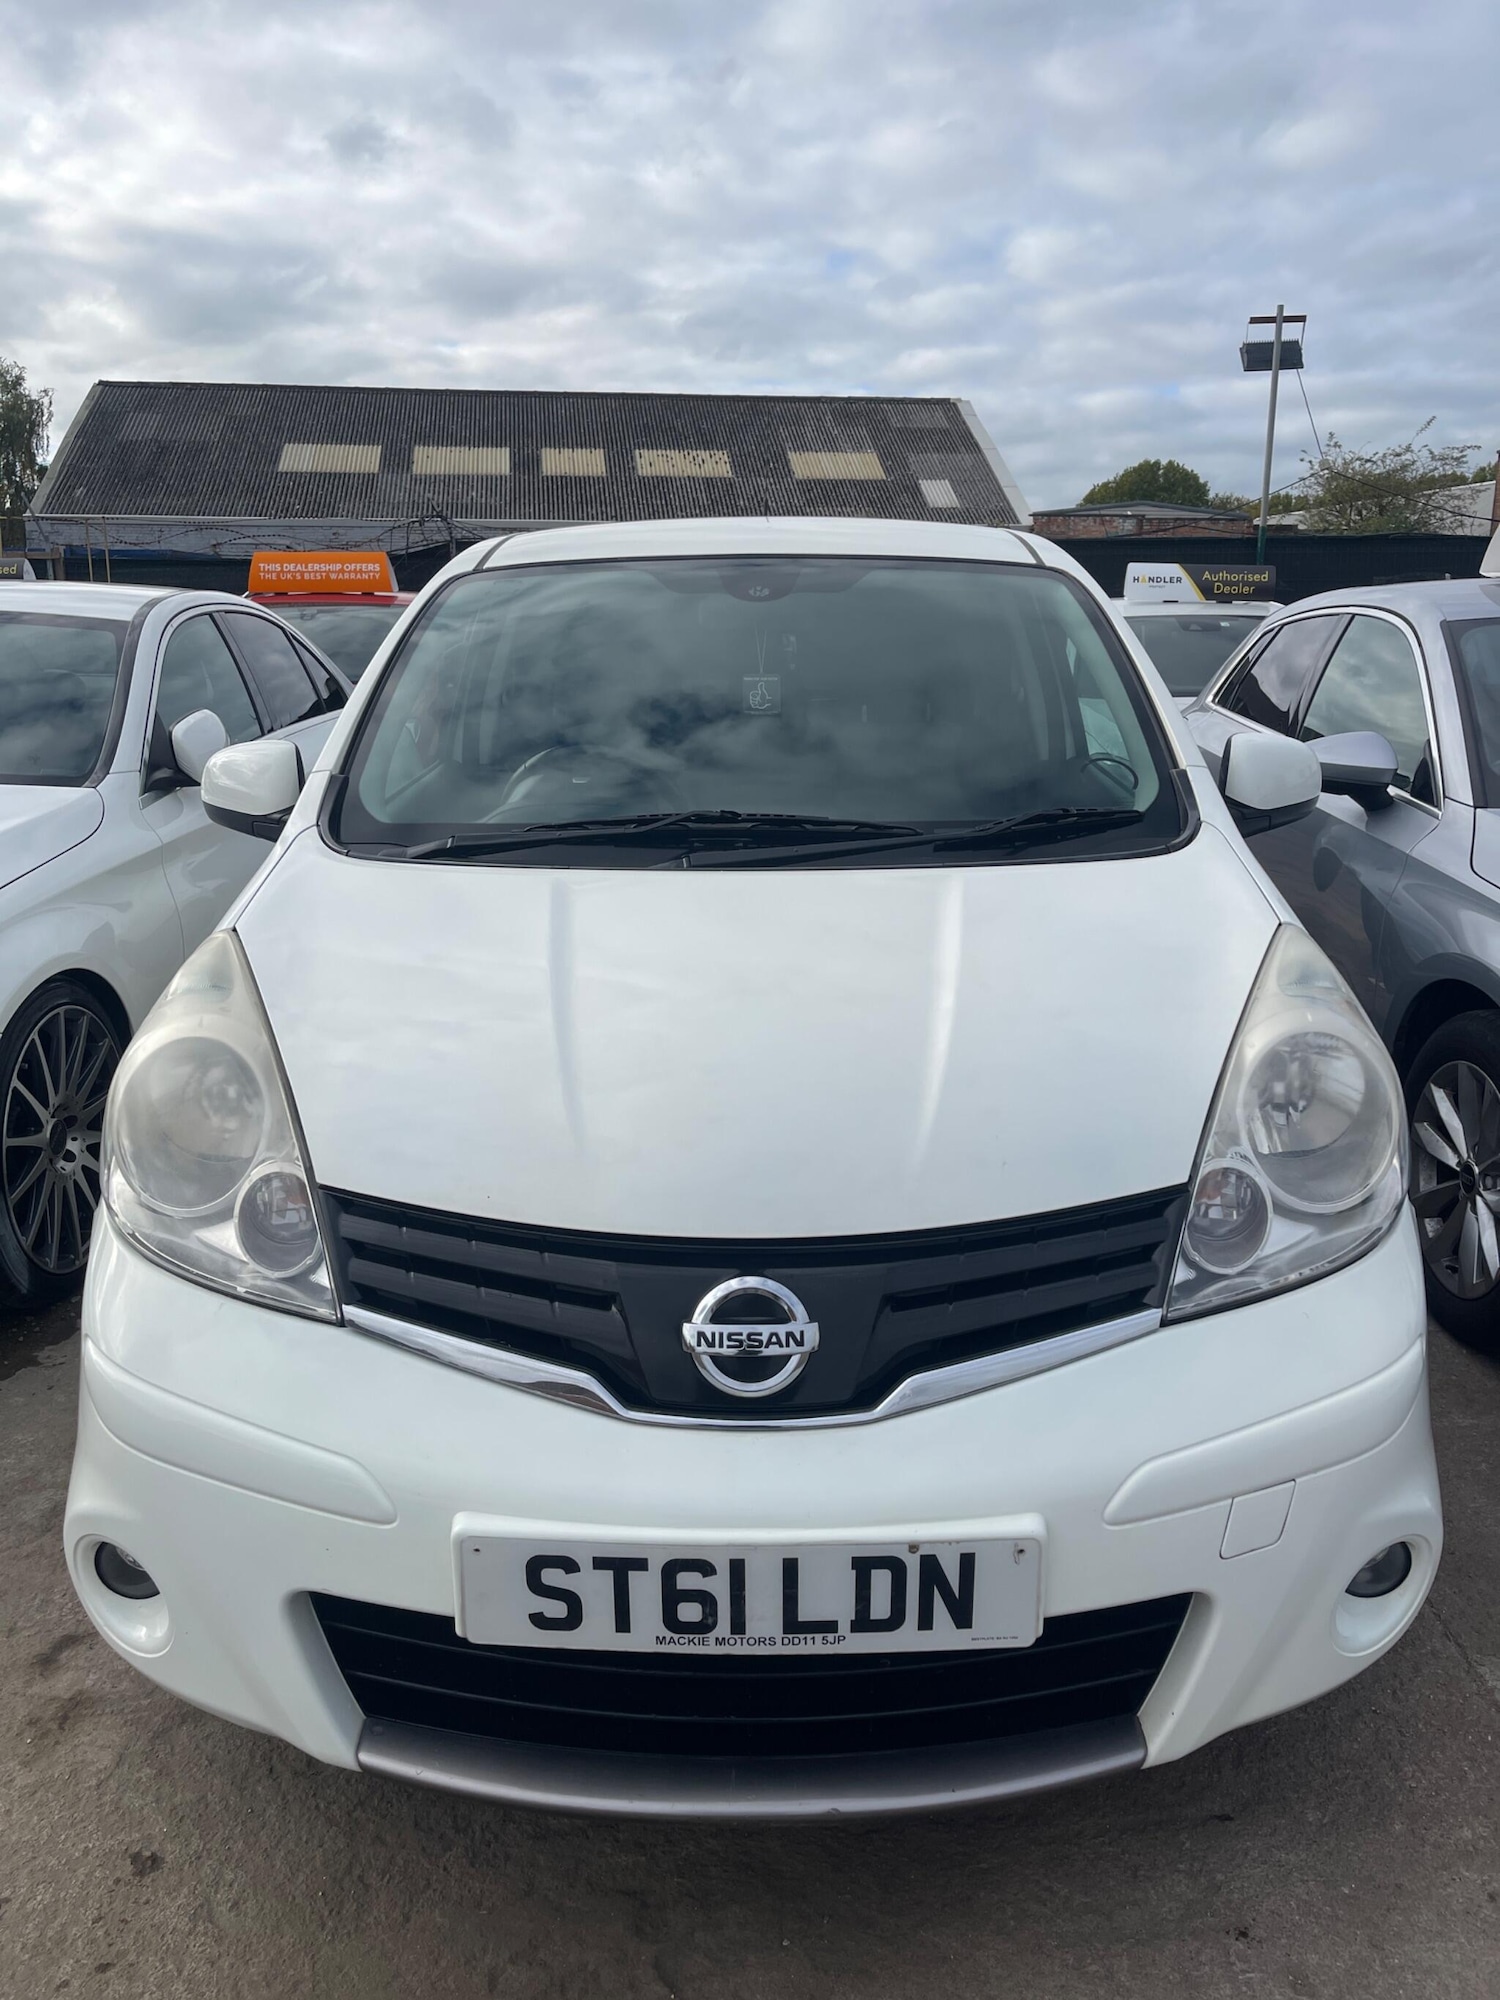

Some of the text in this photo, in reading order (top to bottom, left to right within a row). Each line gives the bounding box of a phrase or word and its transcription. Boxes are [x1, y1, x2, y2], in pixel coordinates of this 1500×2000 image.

[258, 563, 380, 572] THIS DEALERSHIP OFFERS
[259, 572, 380, 580] THE UK'S BEST WARRANTY
[1133, 575, 1182, 584] HANDLER
[1202, 570, 1269, 582] Authorised
[1213, 582, 1255, 594] Dealer
[696, 1330, 805, 1350] NISSAN
[525, 1552, 976, 1635] ST61 LDN
[655, 1635, 846, 1647] MACKIE MOTORS DD11 5JP
